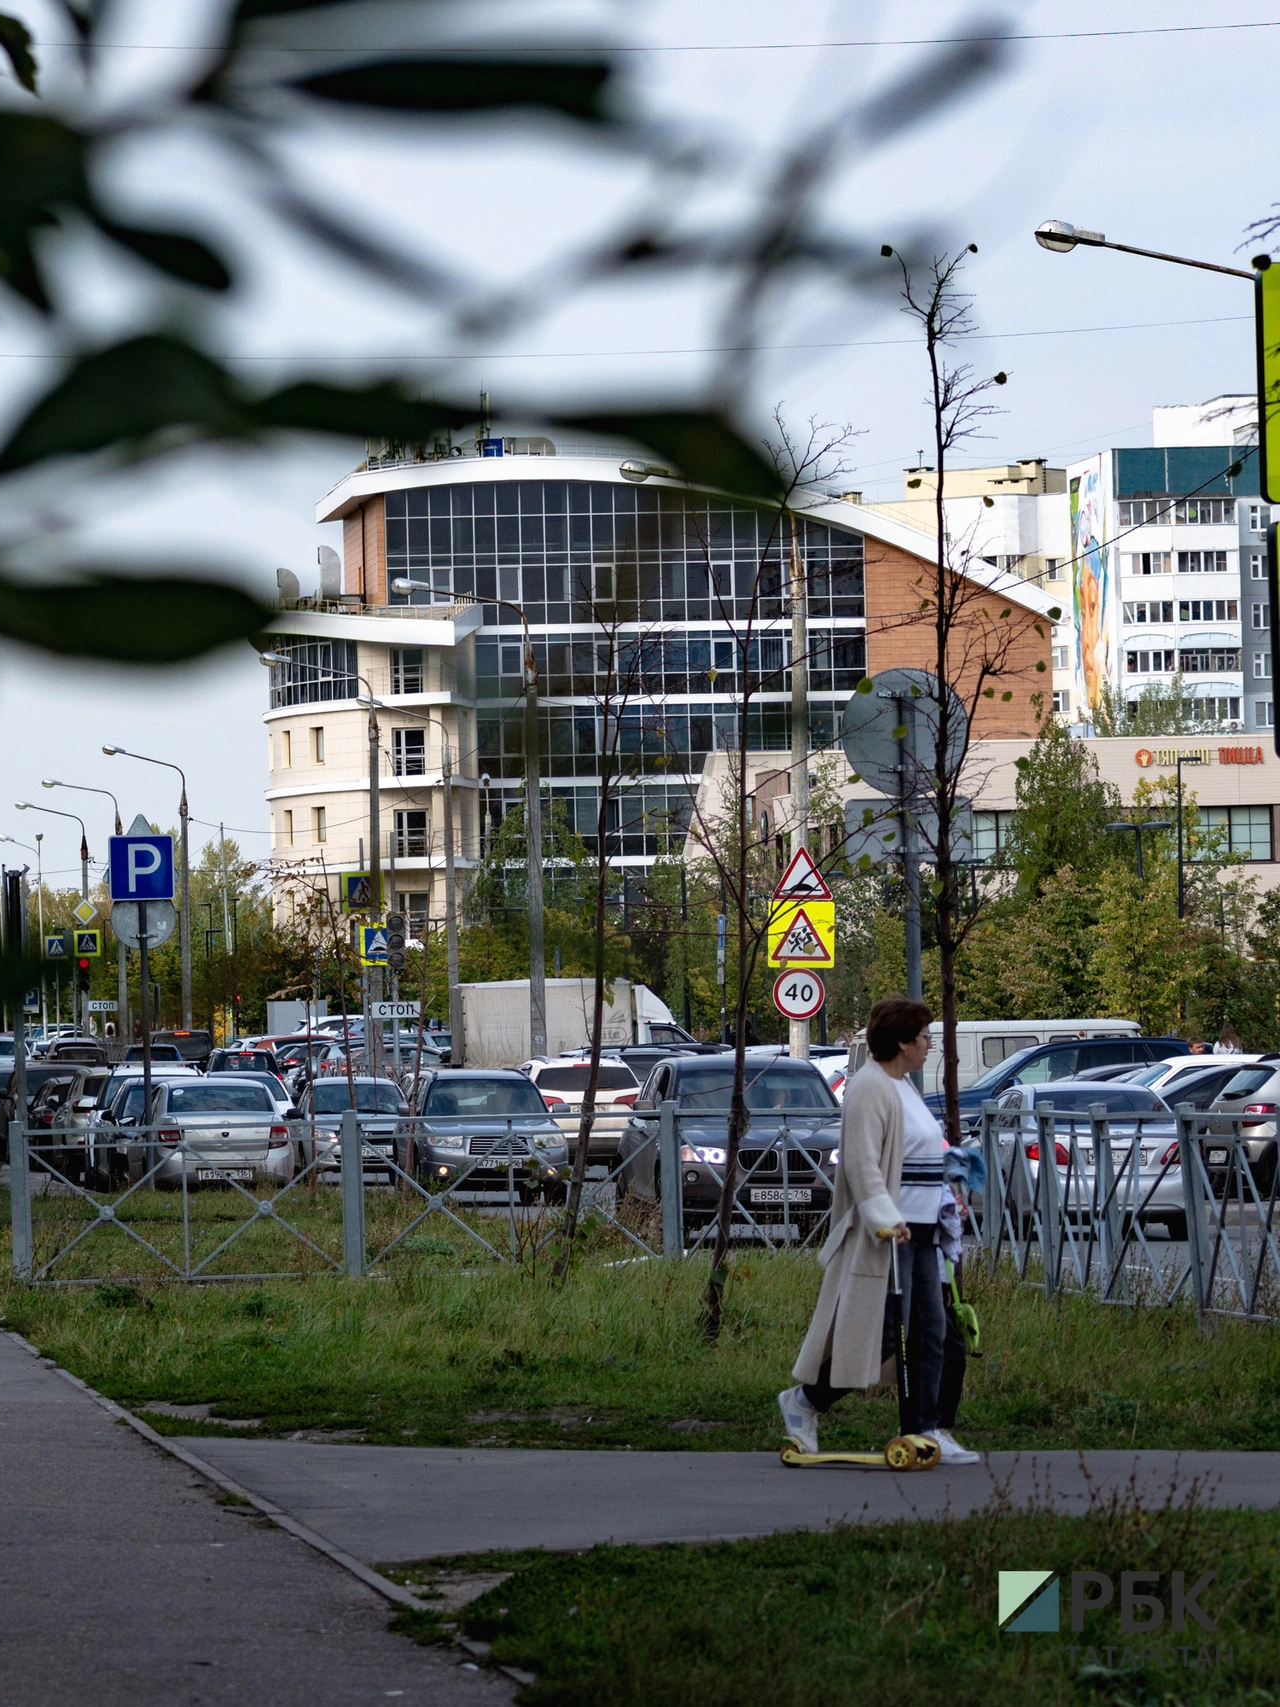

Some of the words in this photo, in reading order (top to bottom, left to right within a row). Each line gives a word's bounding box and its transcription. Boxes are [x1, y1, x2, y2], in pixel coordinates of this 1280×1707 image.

[1217, 746, 1264, 765] ПИЦЦА
[127, 843, 162, 893] P
[784, 983, 814, 1002] 40
[91, 1002, 114, 1010] СТОП
[378, 1004, 414, 1016] СТОП
